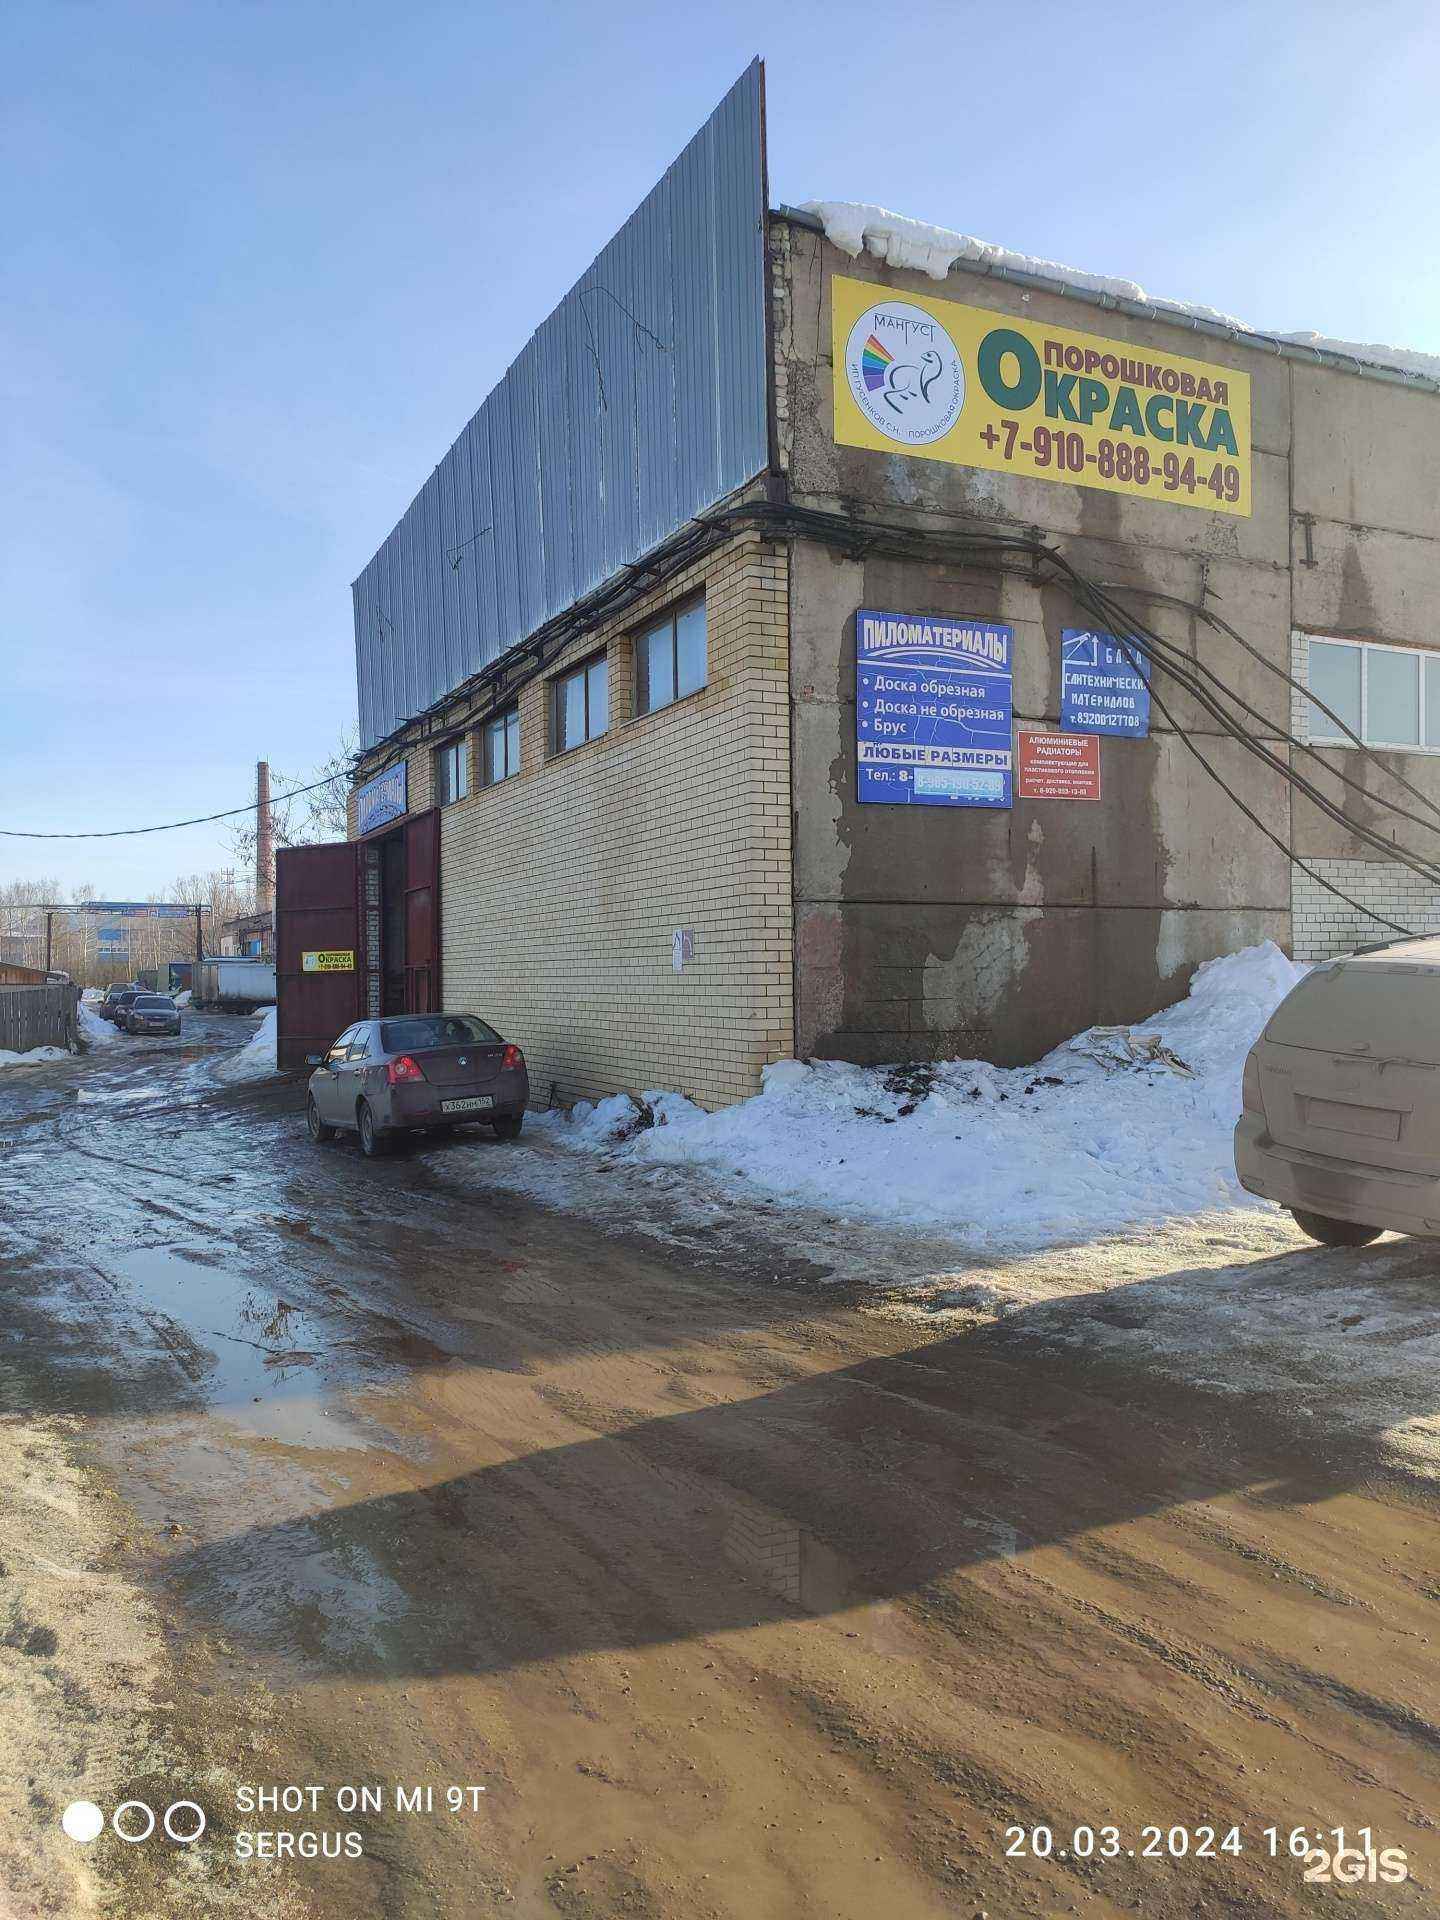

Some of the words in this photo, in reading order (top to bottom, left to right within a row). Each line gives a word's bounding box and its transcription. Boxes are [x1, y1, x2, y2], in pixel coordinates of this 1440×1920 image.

[874, 313, 936, 344] МАНГУСТ
[1044, 339, 1229, 406] ПОРОШКОВАЯ
[978, 328, 1240, 457] ОКРАСКА
[979, 419, 1240, 502] +7-910-888-94-49
[863, 619, 1008, 664] ПИЛОМАТЕРИАЛЫ
[874, 676, 917, 691] Доска
[920, 680, 986, 698] обрезная
[1065, 673, 1151, 690] САНТЕХНИЧЕСКИ
[874, 699, 917, 714] Доска
[920, 705, 938, 716] не
[940, 703, 1005, 721] обрезная
[1071, 693, 1136, 709] МАТЕРИАЛОВ
[874, 719, 907, 735] Брус
[1029, 736, 1089, 747] АЛЮМИНИЕВЫЕ
[1036, 747, 1082, 756] РАДИАТОРЫ
[863, 746, 926, 761] ЛЮБЫЕ
[930, 750, 1008, 766] РАЗМЕРЫ
[866, 768, 896, 782] Тел.:
